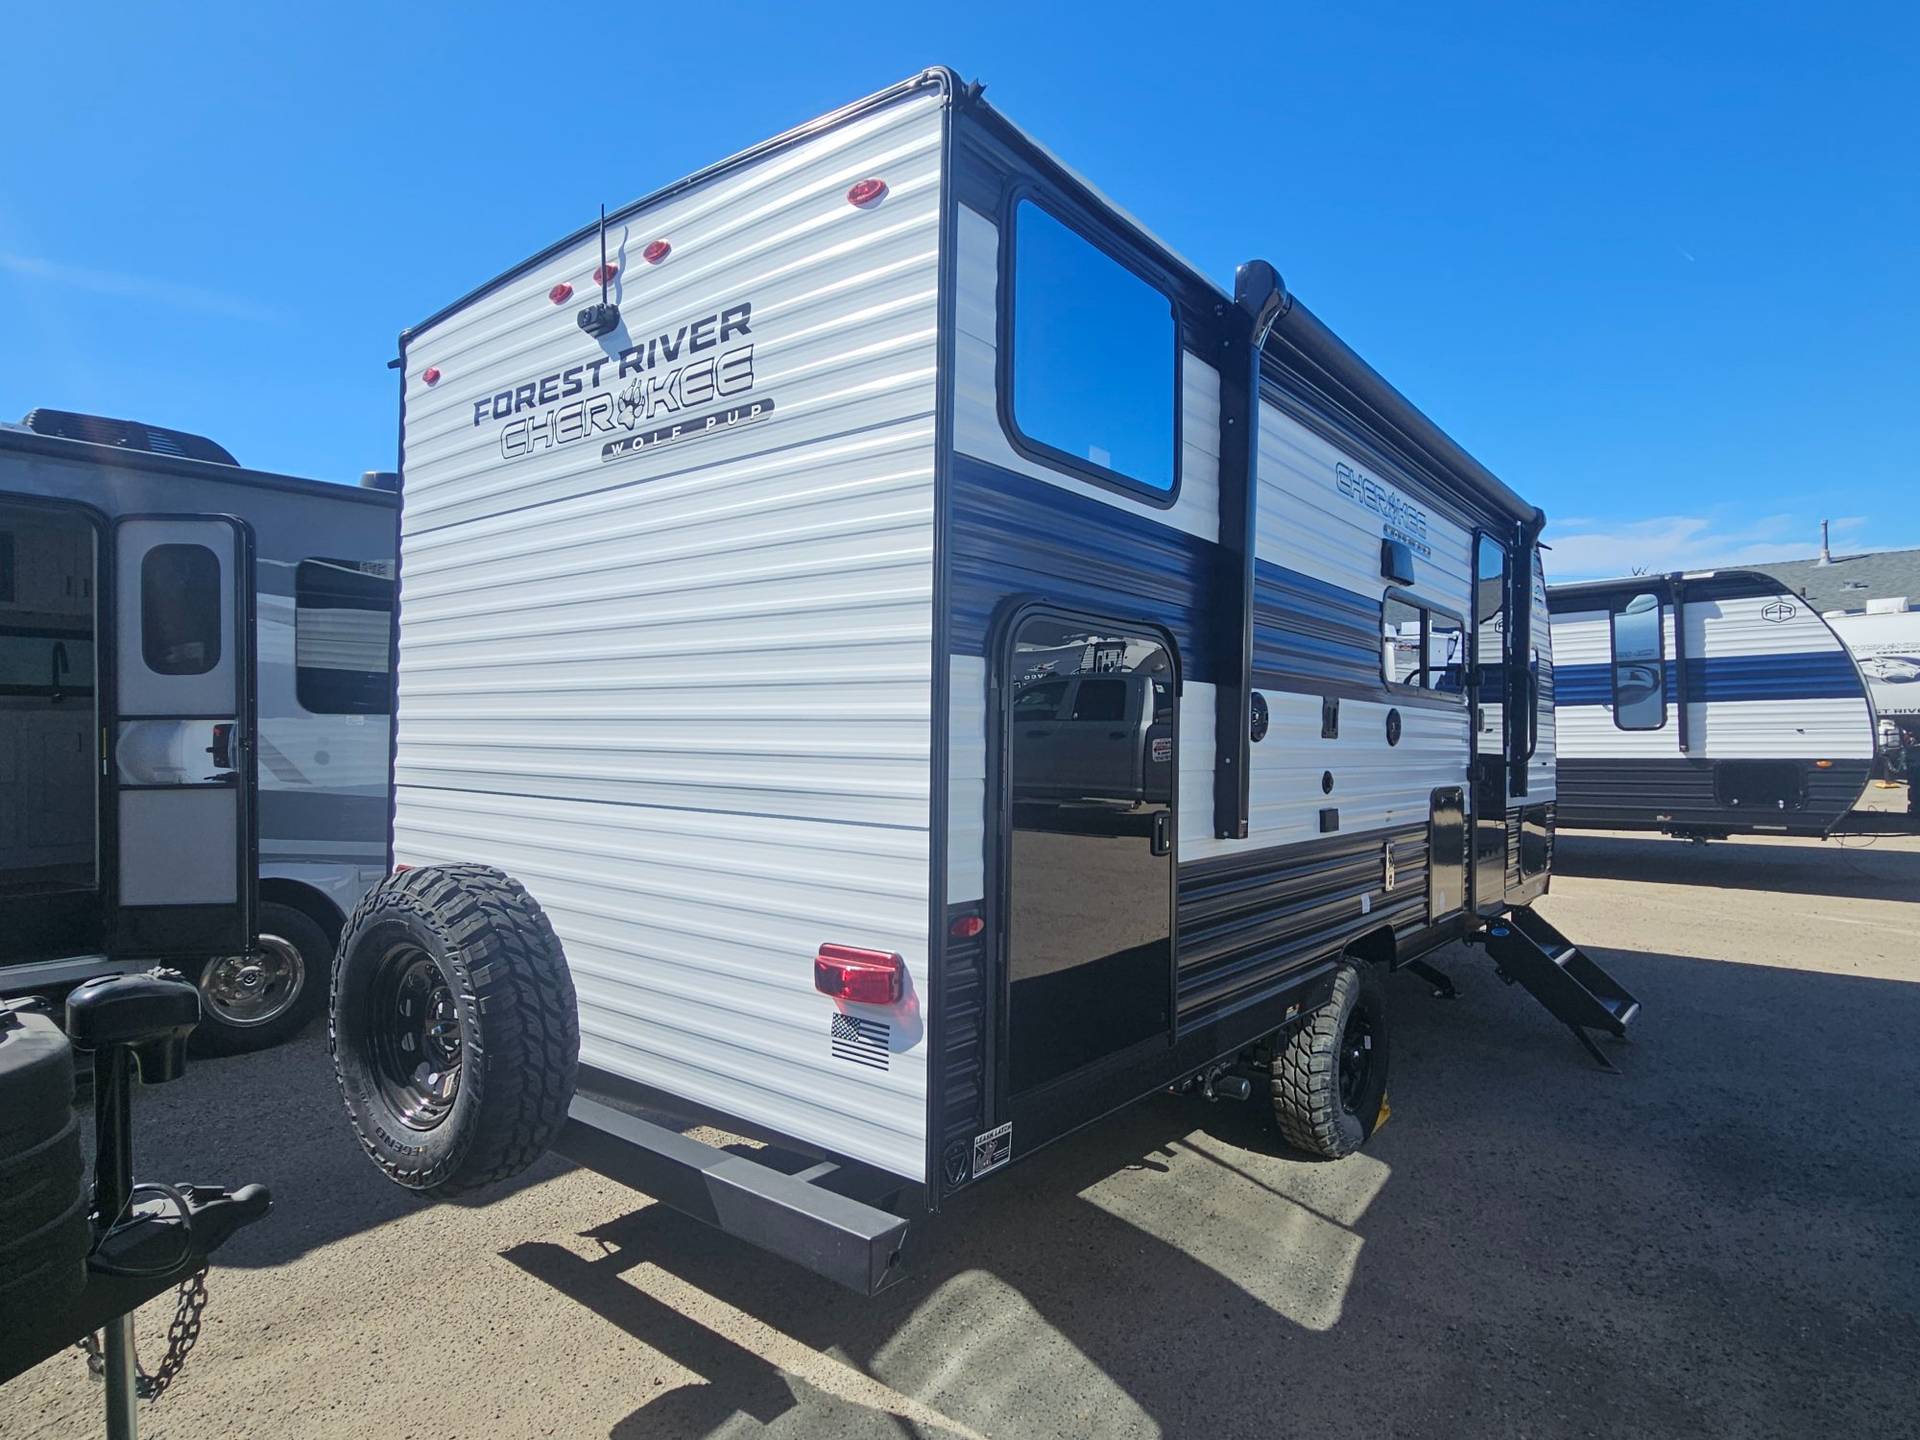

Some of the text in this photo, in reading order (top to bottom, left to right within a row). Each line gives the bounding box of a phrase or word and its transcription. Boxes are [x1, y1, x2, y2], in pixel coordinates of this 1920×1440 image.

[473, 301, 753, 427] FOREST RIVER
[611, 404, 763, 456] WOLF PUP
